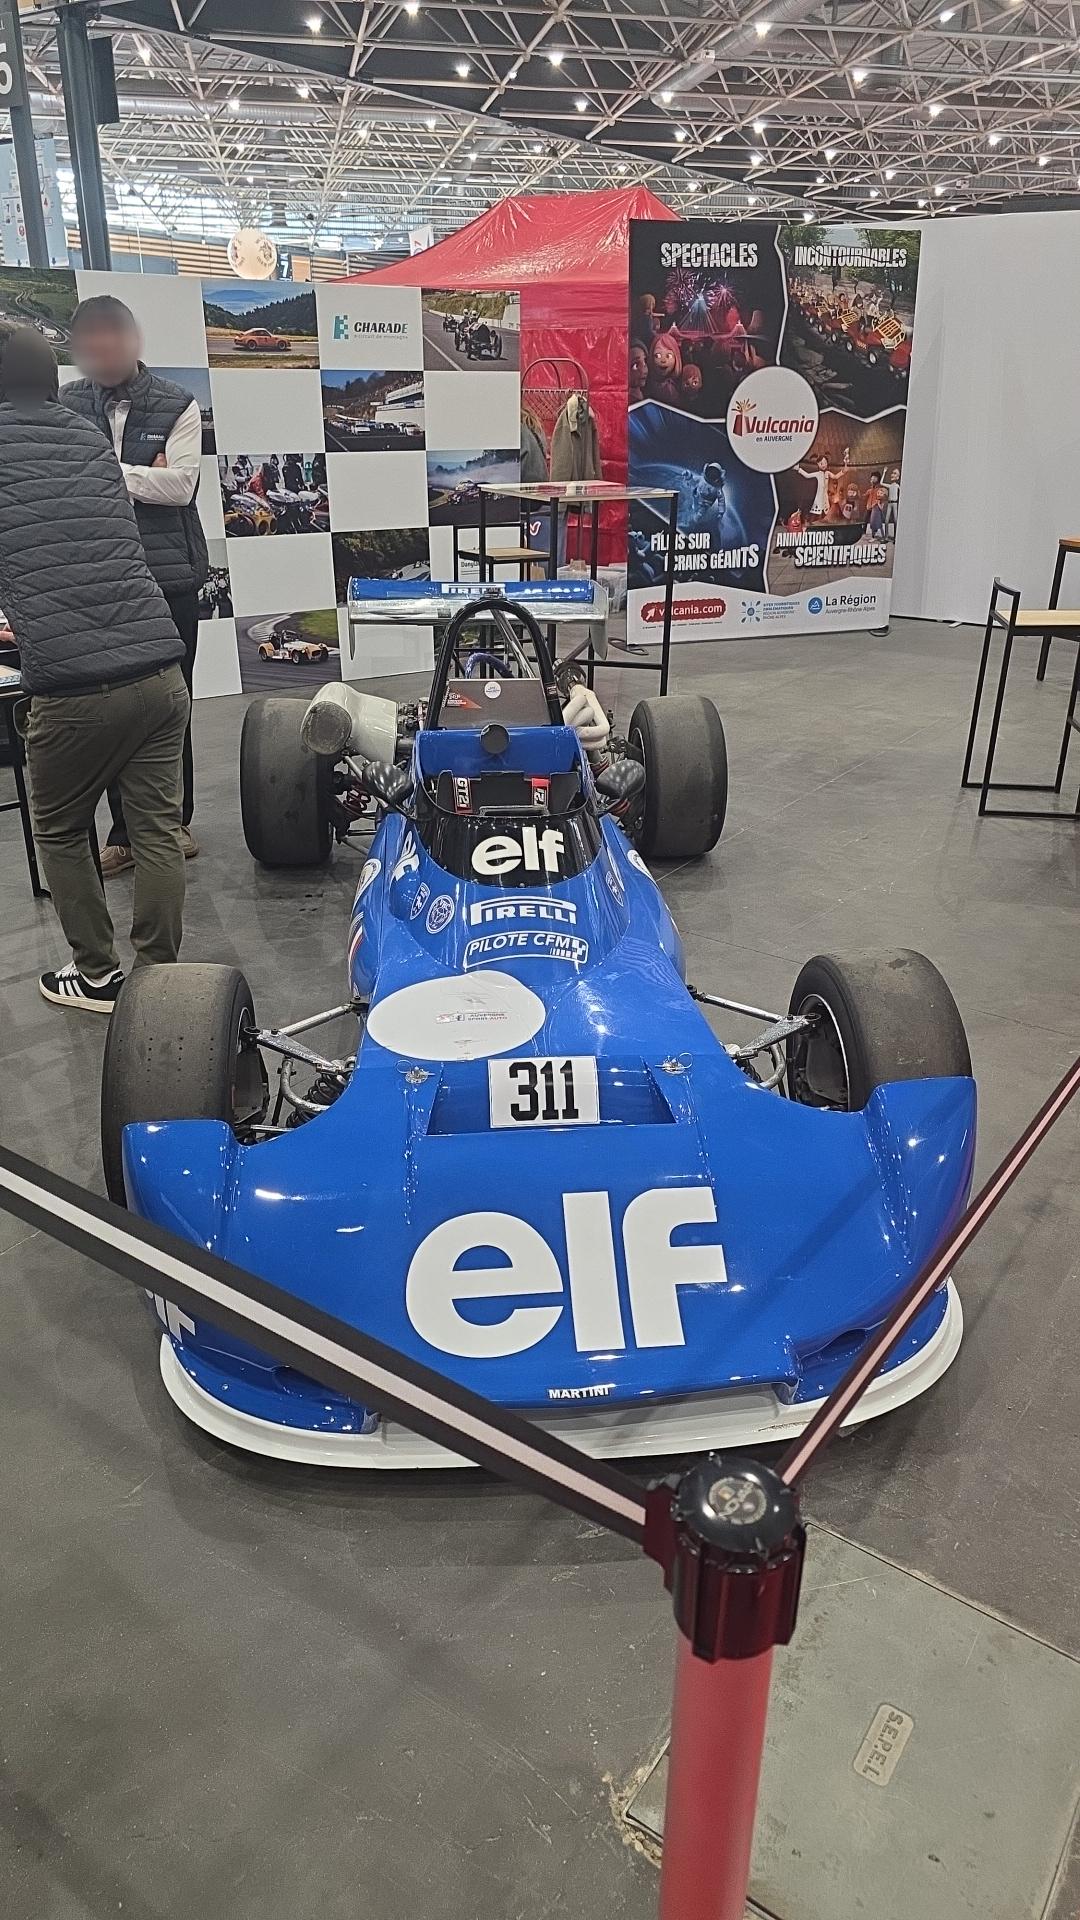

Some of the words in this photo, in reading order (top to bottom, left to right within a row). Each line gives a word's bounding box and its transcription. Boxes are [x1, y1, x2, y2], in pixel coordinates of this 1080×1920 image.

[661, 243, 758, 267] SPECTACLES
[794, 245, 907, 267] INCONTOURNABLES
[354, 322, 408, 333] CHARADE
[744, 415, 815, 433] Vulcania
[688, 533, 711, 550] SUR
[776, 531, 834, 547] ANIMATIONS
[710, 544, 760, 569] GÉANTS
[795, 544, 886, 567] SCIENTIFIQUES
[659, 605, 723, 616] vlcania.com
[826, 597, 837, 606] La
[840, 594, 876, 606] Région
[471, 826, 565, 875] elf
[470, 895, 577, 926] PIRELLI
[469, 933, 529, 956] PILOTE
[533, 933, 570, 948] CFM
[509, 1060, 579, 1121] 311
[406, 1186, 728, 1359] elf
[549, 1386, 610, 1399] MARTINI
